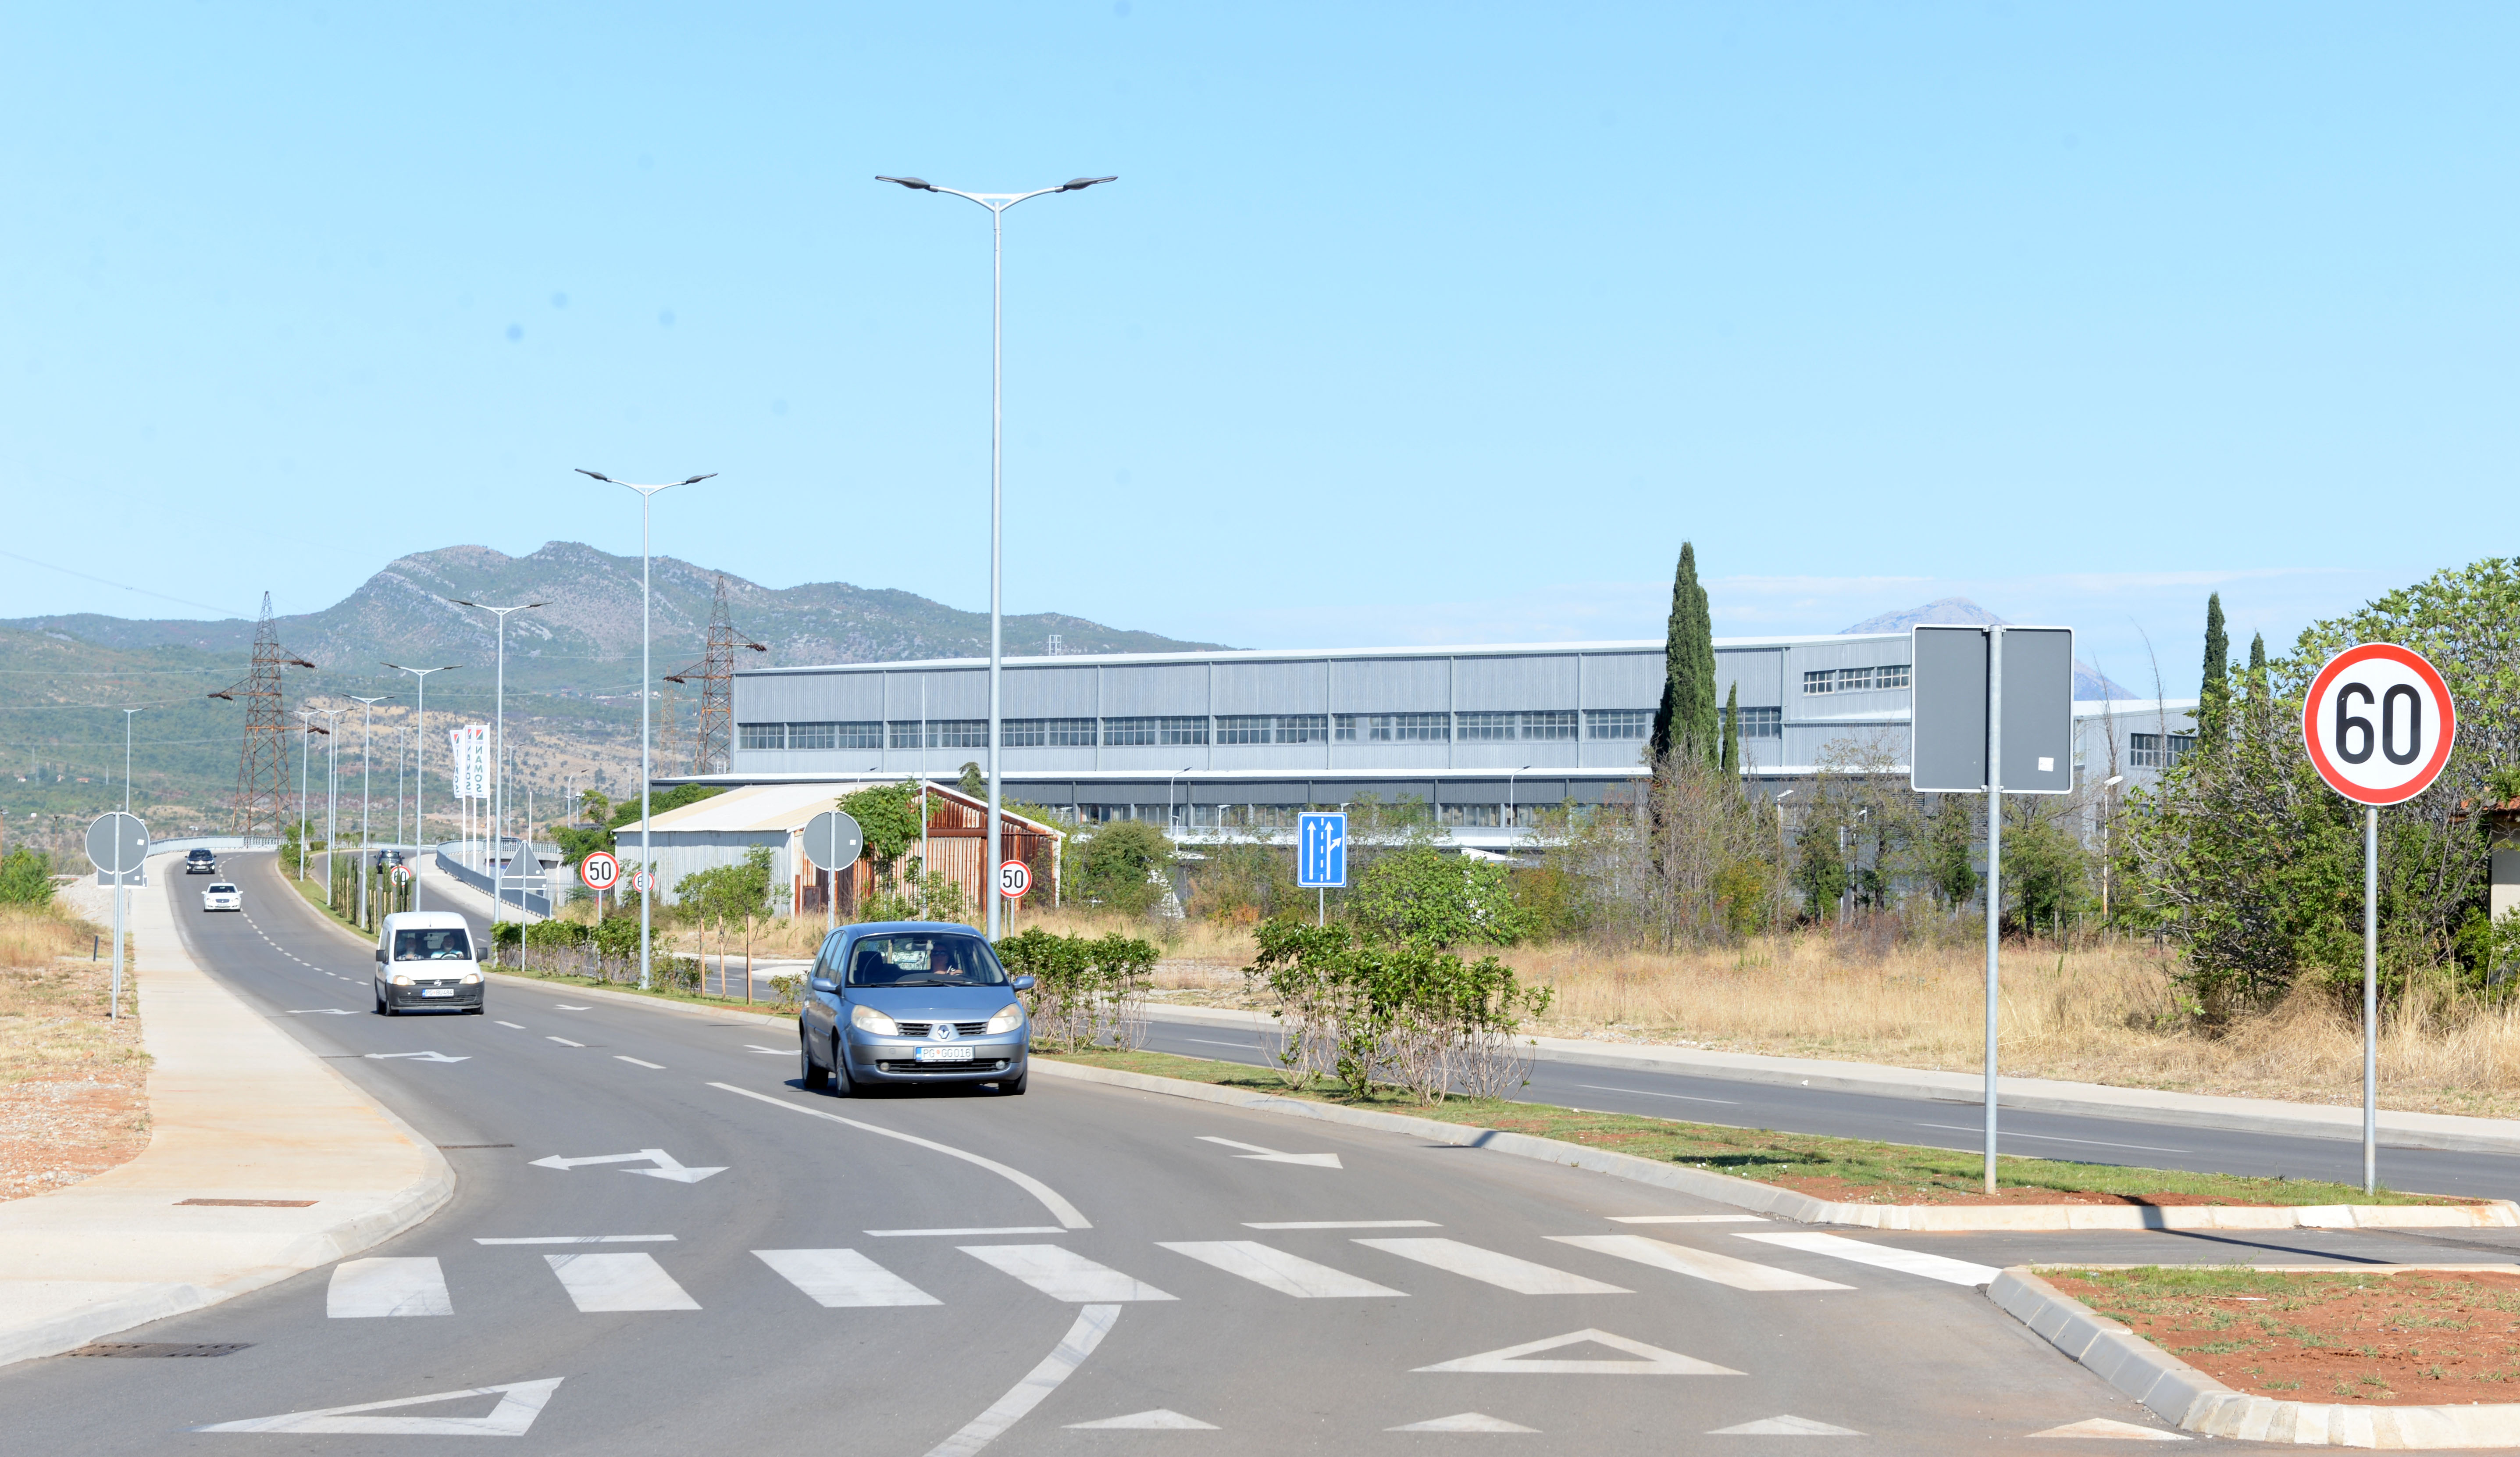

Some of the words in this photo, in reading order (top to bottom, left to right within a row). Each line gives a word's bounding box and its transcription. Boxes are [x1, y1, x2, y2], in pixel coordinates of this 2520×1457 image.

[2336, 682, 2421, 765] 60
[590, 861, 611, 880] 50
[1003, 870, 1023, 888] 50
[923, 1049, 934, 1058] PG
[941, 1049, 971, 1057] GG016
